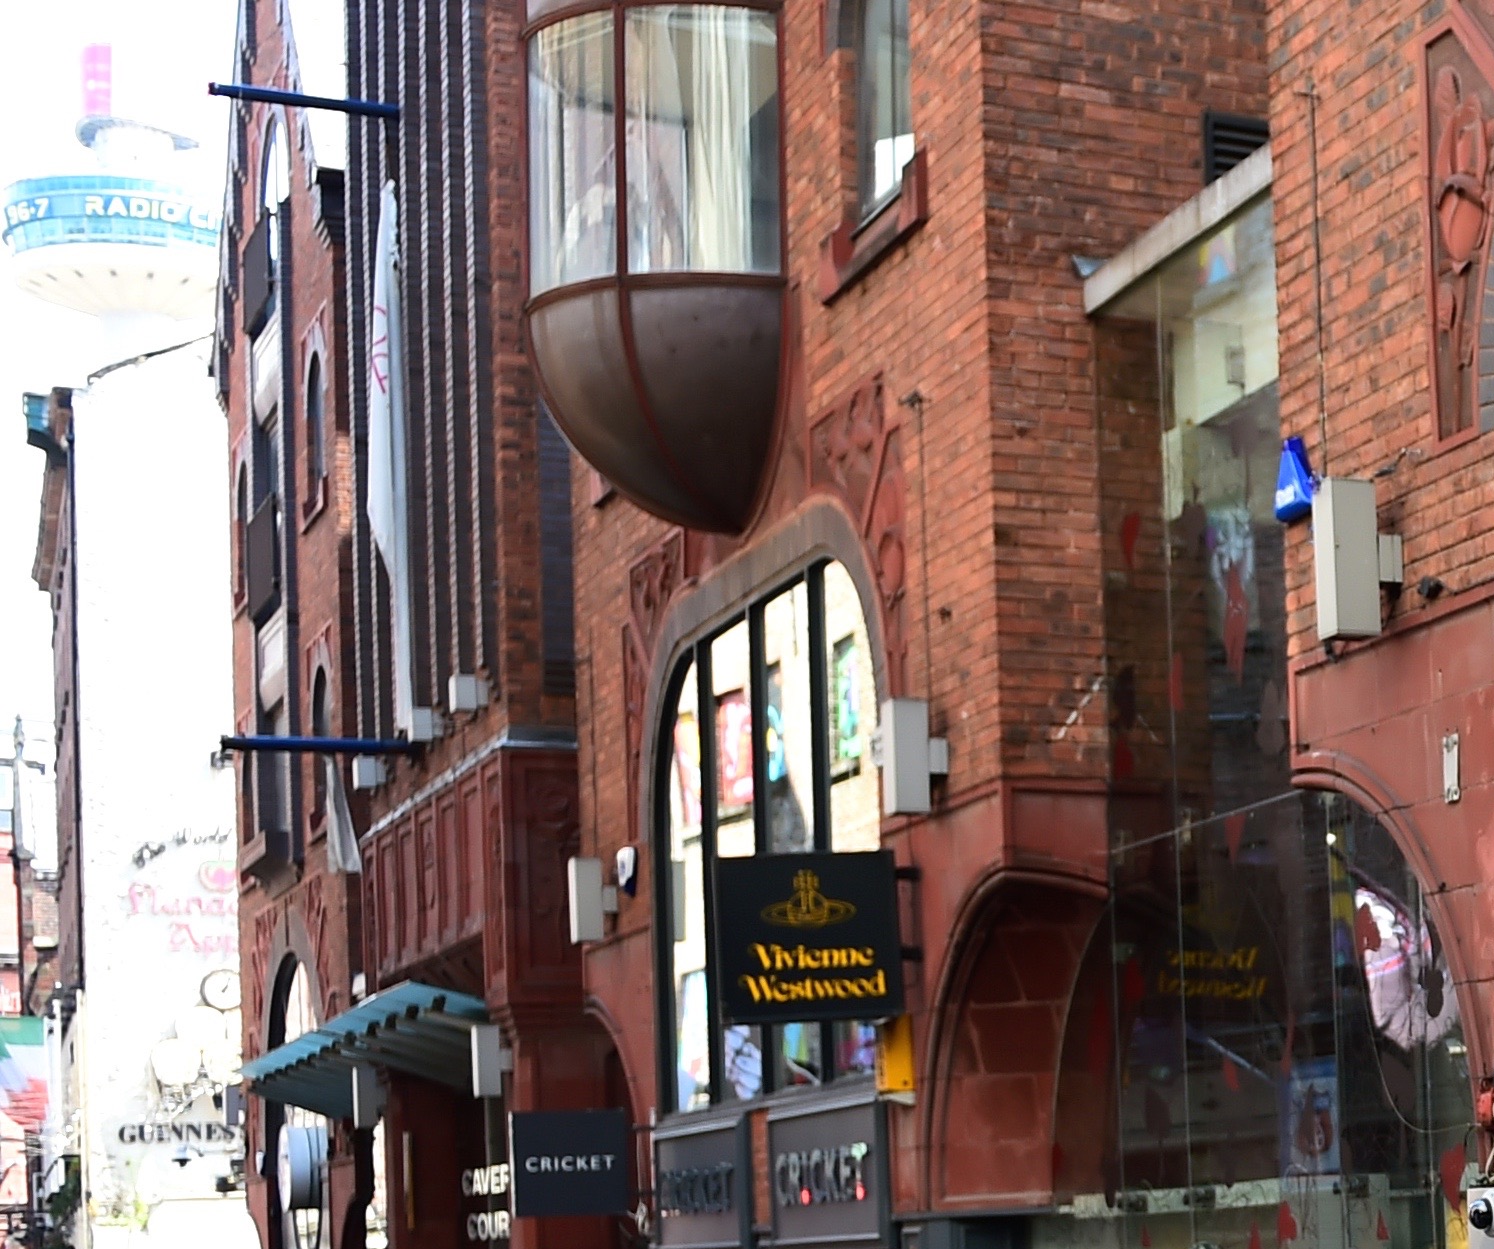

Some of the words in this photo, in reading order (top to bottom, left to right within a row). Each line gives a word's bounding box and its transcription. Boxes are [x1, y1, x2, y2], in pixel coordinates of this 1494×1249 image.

[84, 195, 182, 223] RADIO
[748, 943, 877, 971] Vivienne
[741, 968, 888, 1003] Westwood
[524, 1153, 616, 1173] CRICKET
[775, 1142, 869, 1206] CRICKET
